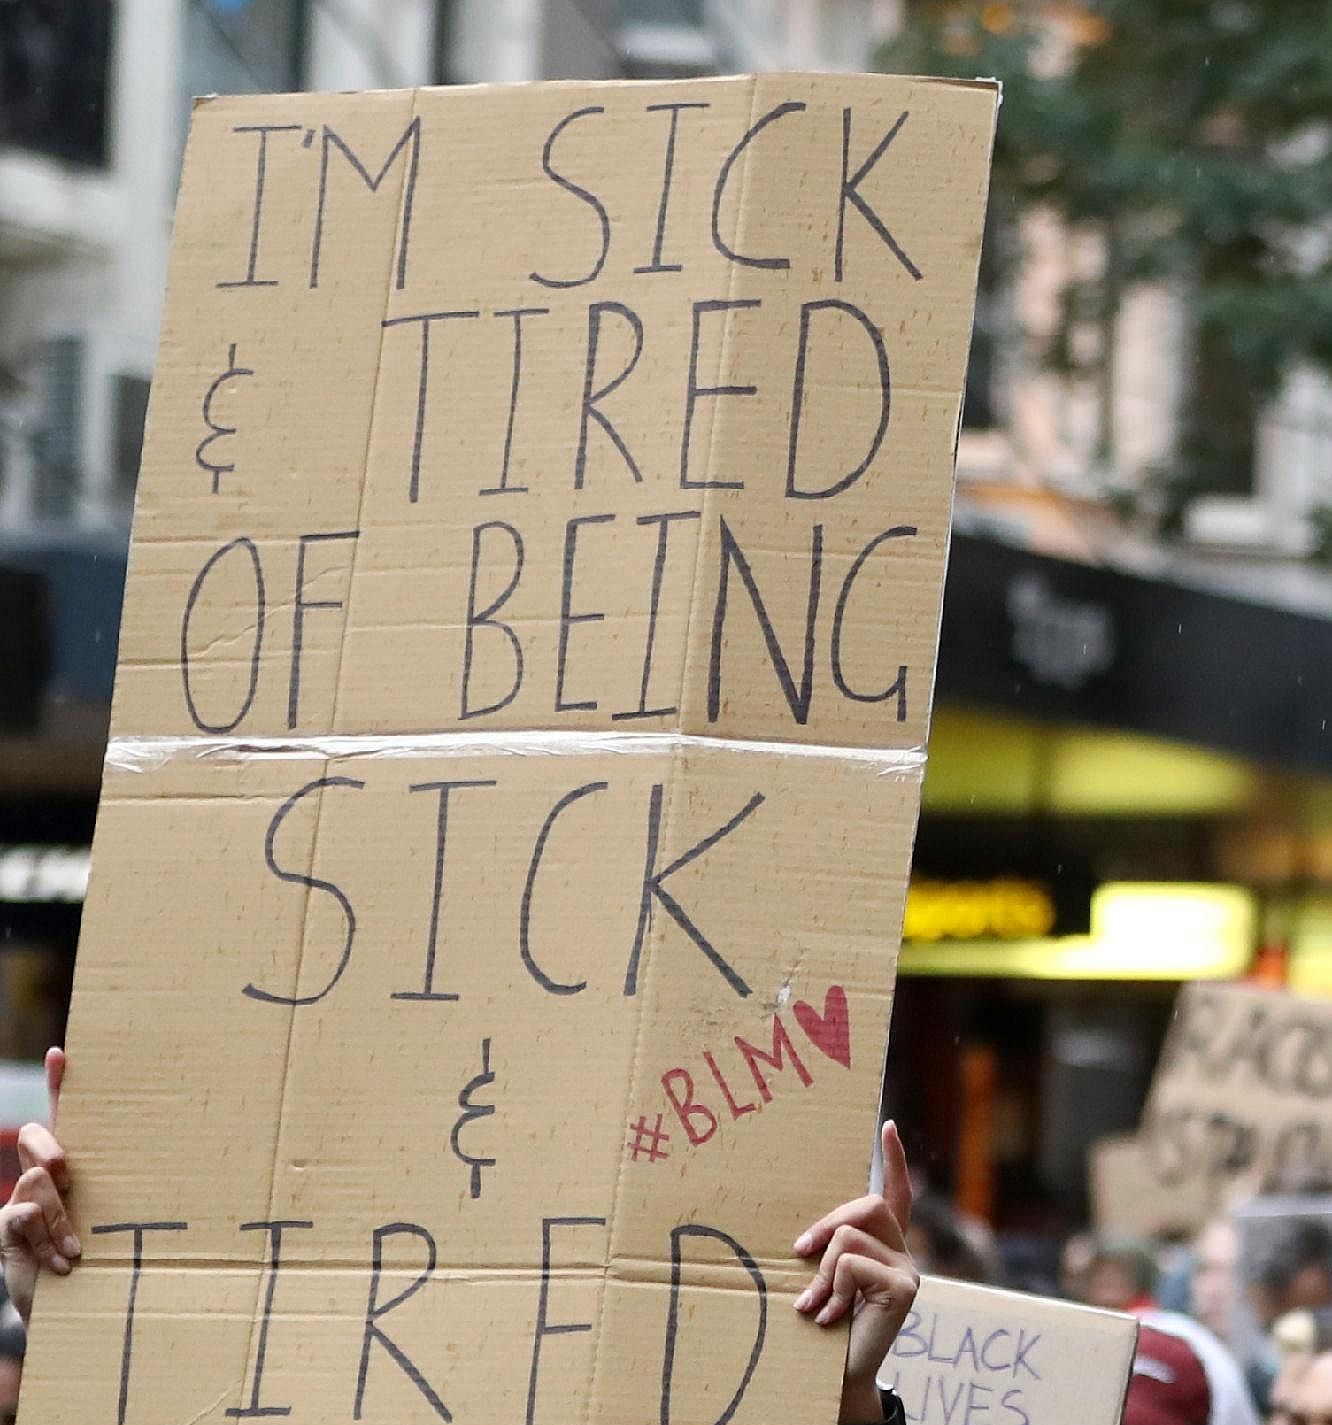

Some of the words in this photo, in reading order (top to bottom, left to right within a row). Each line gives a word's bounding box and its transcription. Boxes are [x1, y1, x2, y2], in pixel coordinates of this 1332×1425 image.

[215, 114, 423, 290] I'M
[528, 101, 924, 290] SICK
[194, 342, 255, 495] &
[381, 298, 891, 504] TIRED
[180, 530, 361, 735] OF
[457, 511, 919, 726] BEING
[242, 776, 766, 1006] SICK
[450, 1037, 498, 1199] &
[626, 1010, 815, 1164] #BLM
[891, 1310, 1042, 1381] BLACK
